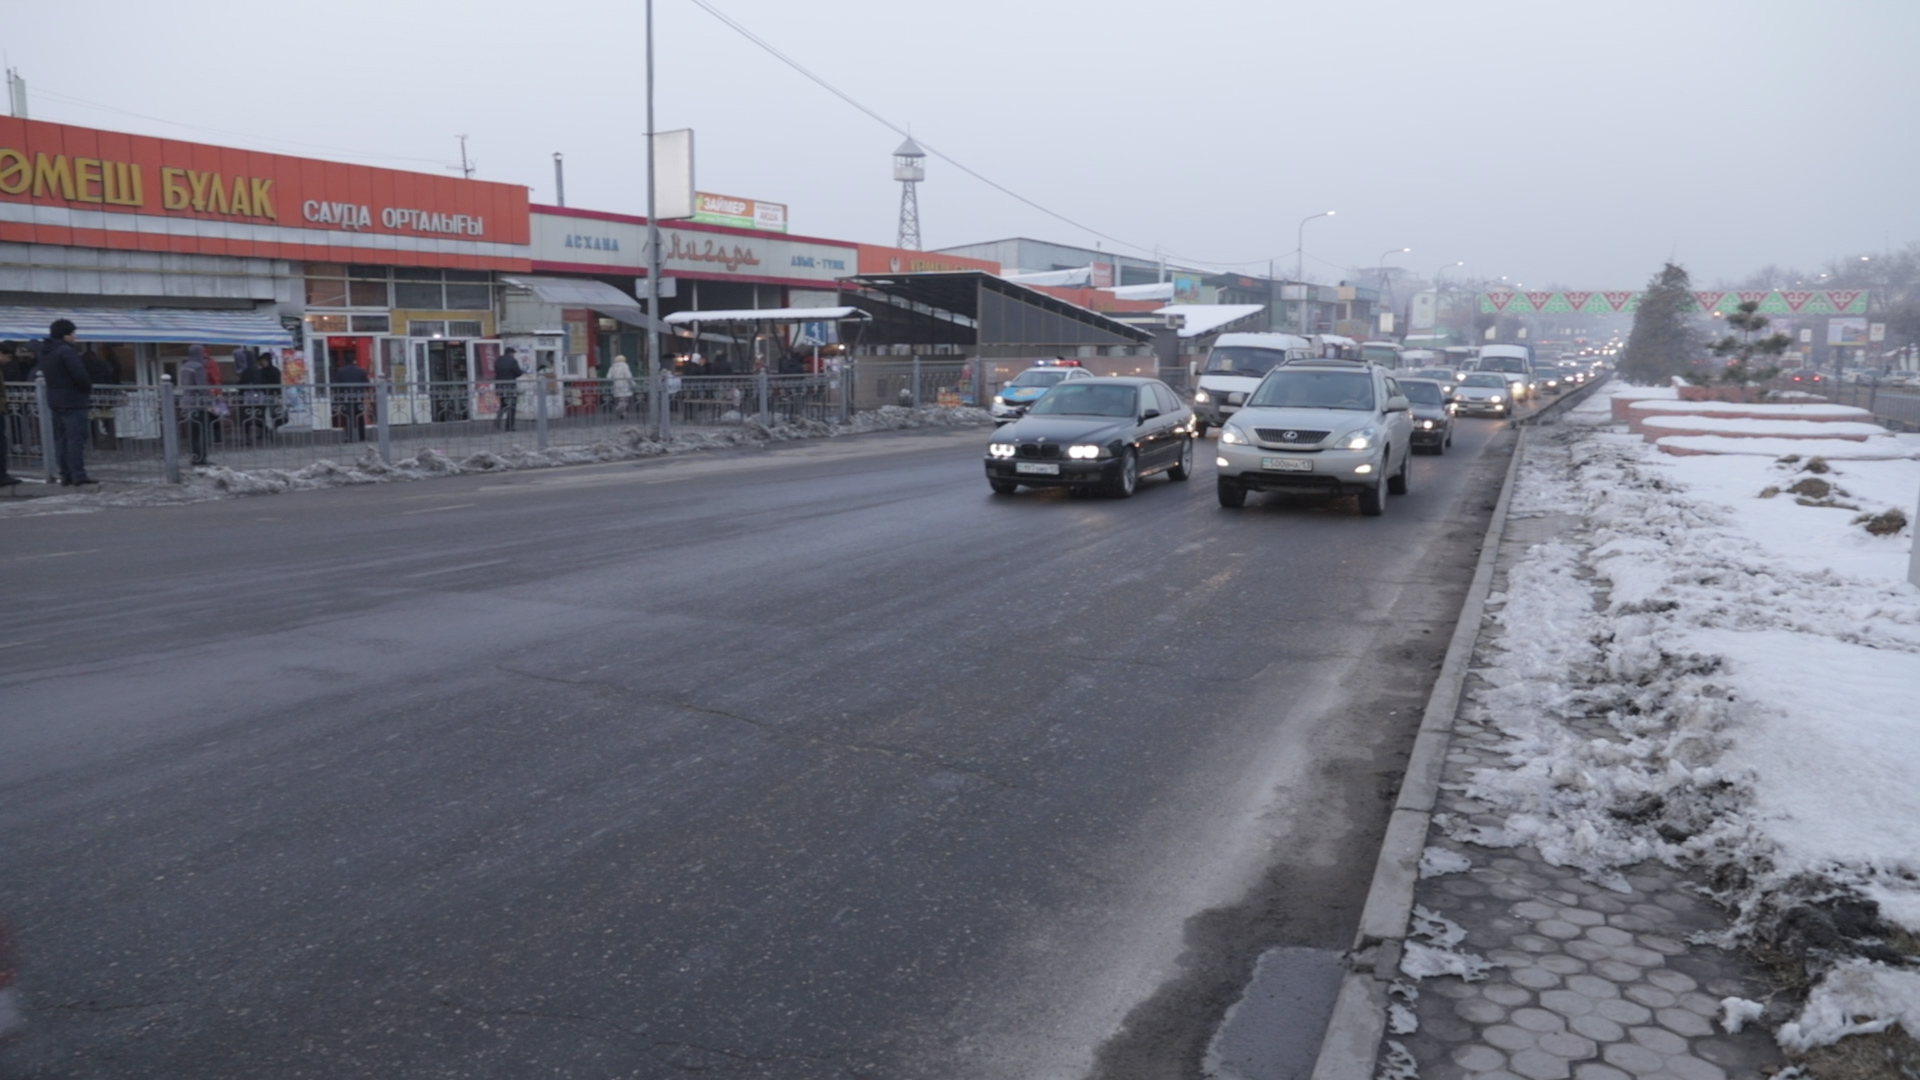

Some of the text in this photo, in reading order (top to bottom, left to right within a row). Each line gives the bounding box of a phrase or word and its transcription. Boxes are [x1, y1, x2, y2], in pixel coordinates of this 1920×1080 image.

[161, 166, 276, 221] БҰЛАҚ
[703, 196, 747, 214] ЗАЙМЕР
[303, 200, 483, 235] САУДА ОРТАЛЫҒЫ
[565, 234, 619, 251] АСХАНА
